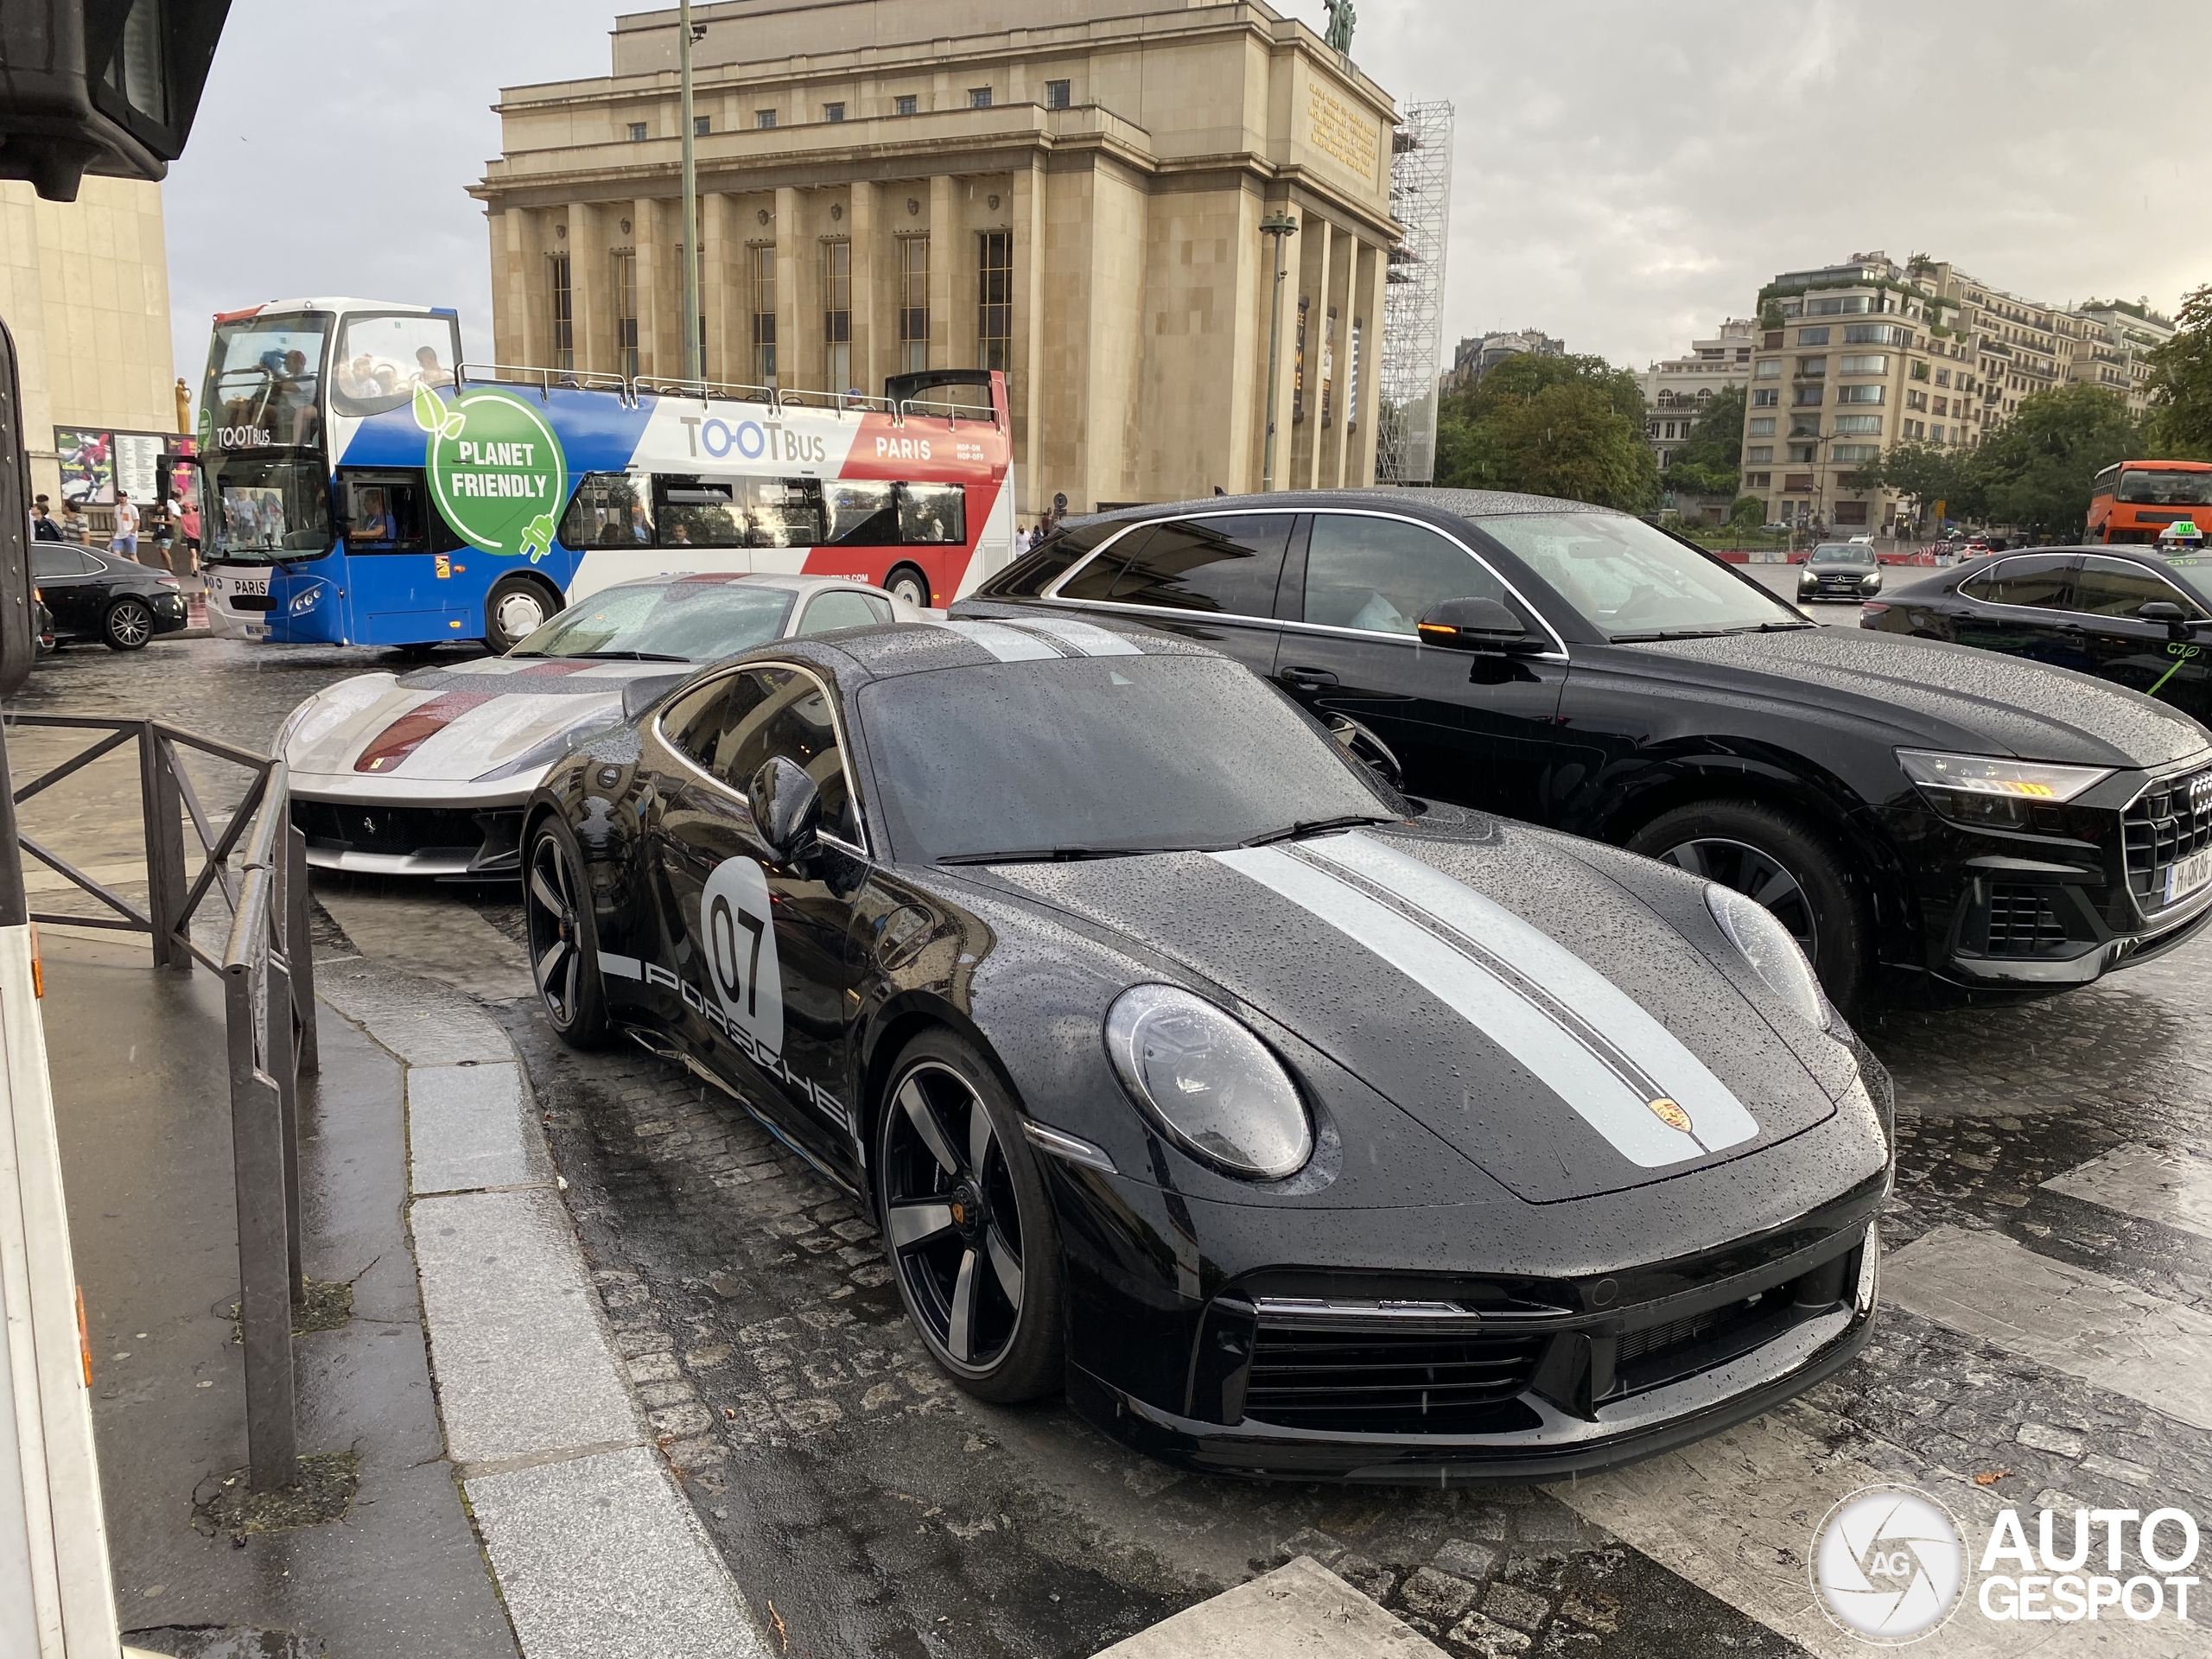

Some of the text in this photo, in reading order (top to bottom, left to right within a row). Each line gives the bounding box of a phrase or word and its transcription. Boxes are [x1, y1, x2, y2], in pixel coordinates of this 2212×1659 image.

[458, 441, 535, 467] PLANET
[875, 436, 931, 461] PARIS
[956, 443, 981, 452] HOP-ON
[451, 473, 547, 498] FRIENDLY
[2180, 523, 2194, 532] TAXI
[234, 580, 267, 594] PARIS
[2167, 642, 2187, 655] G7
[710, 894, 765, 1018] 07
[646, 961, 849, 1131] PORSCHE
